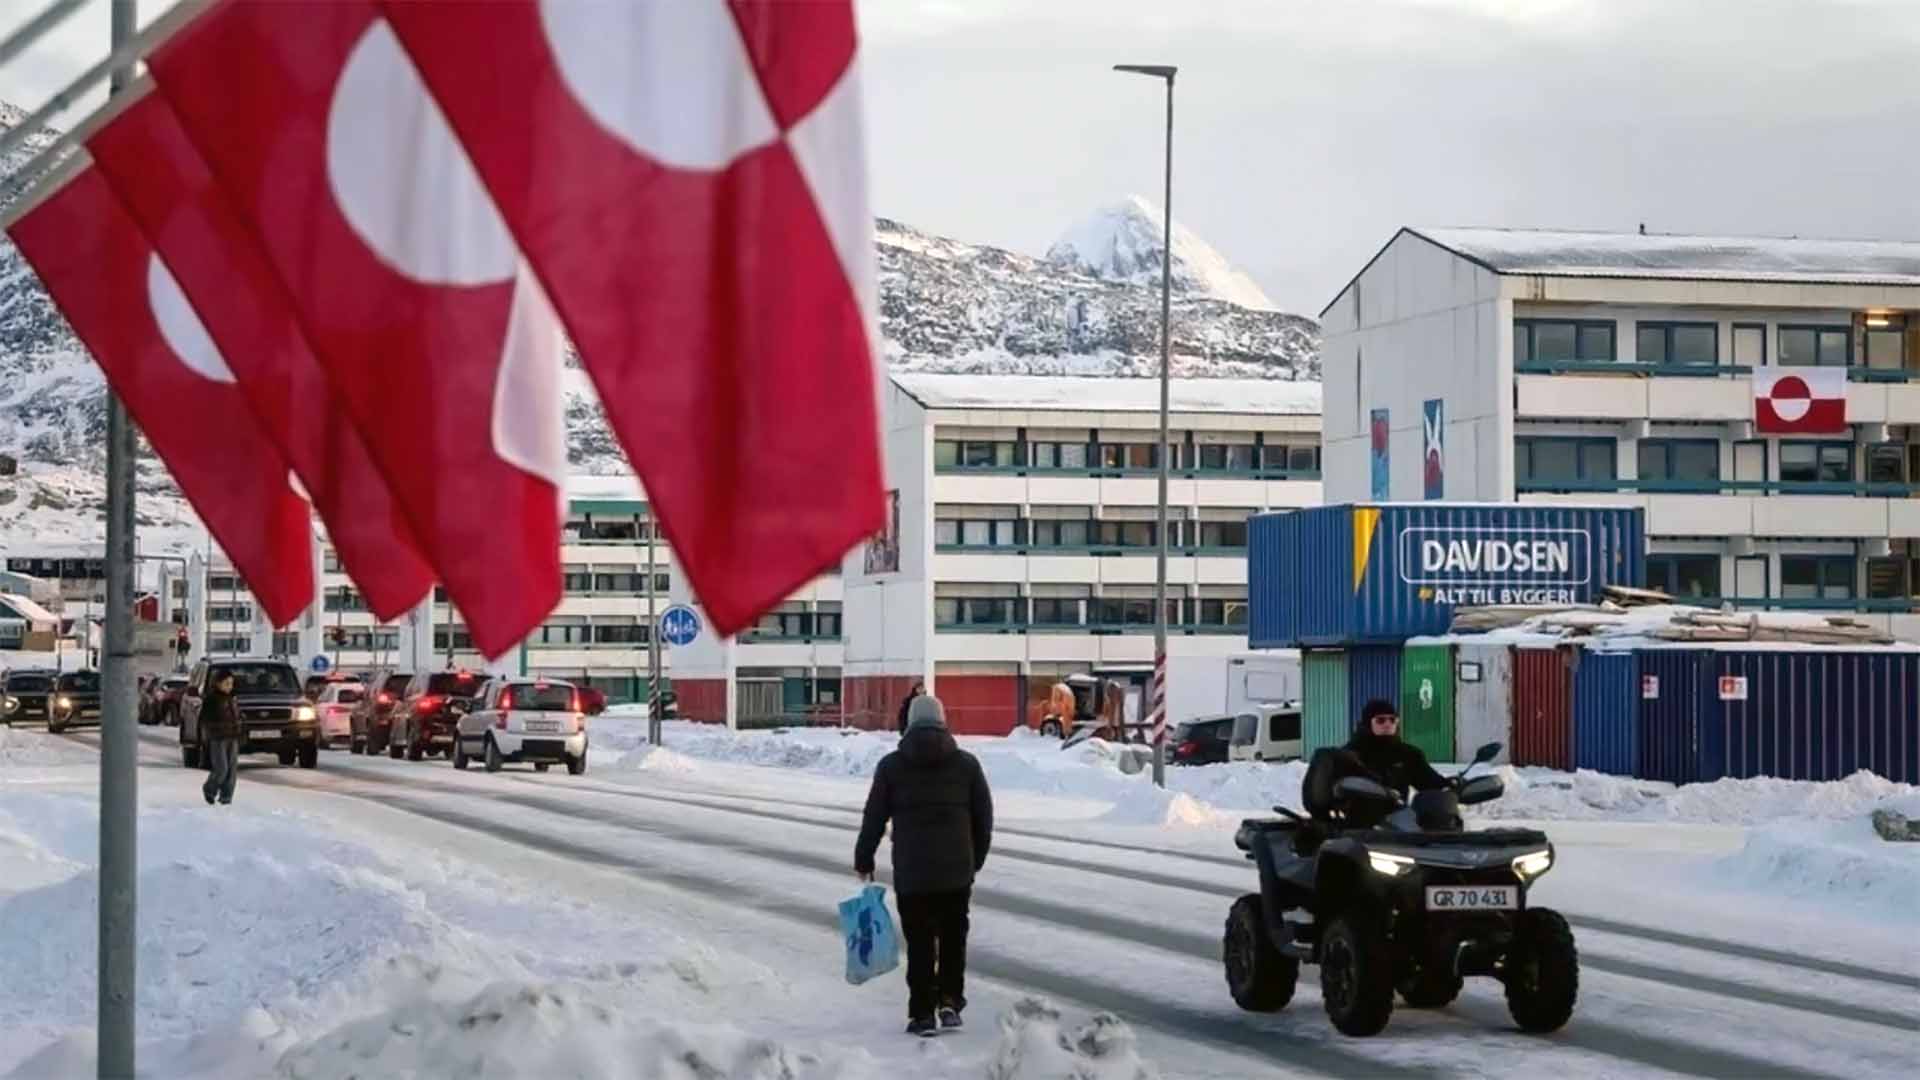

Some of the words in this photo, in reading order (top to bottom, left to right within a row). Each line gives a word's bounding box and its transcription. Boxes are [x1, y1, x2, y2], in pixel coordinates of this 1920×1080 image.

[1422, 539, 1569, 573] DAVIDSEN
[1434, 589, 1466, 605] ALT
[1469, 589, 1496, 605] TIL
[1501, 588, 1575, 605] BYGGERI
[1433, 890, 1455, 907] GR
[1459, 890, 1478, 906] 70
[1481, 890, 1507, 906] 431
